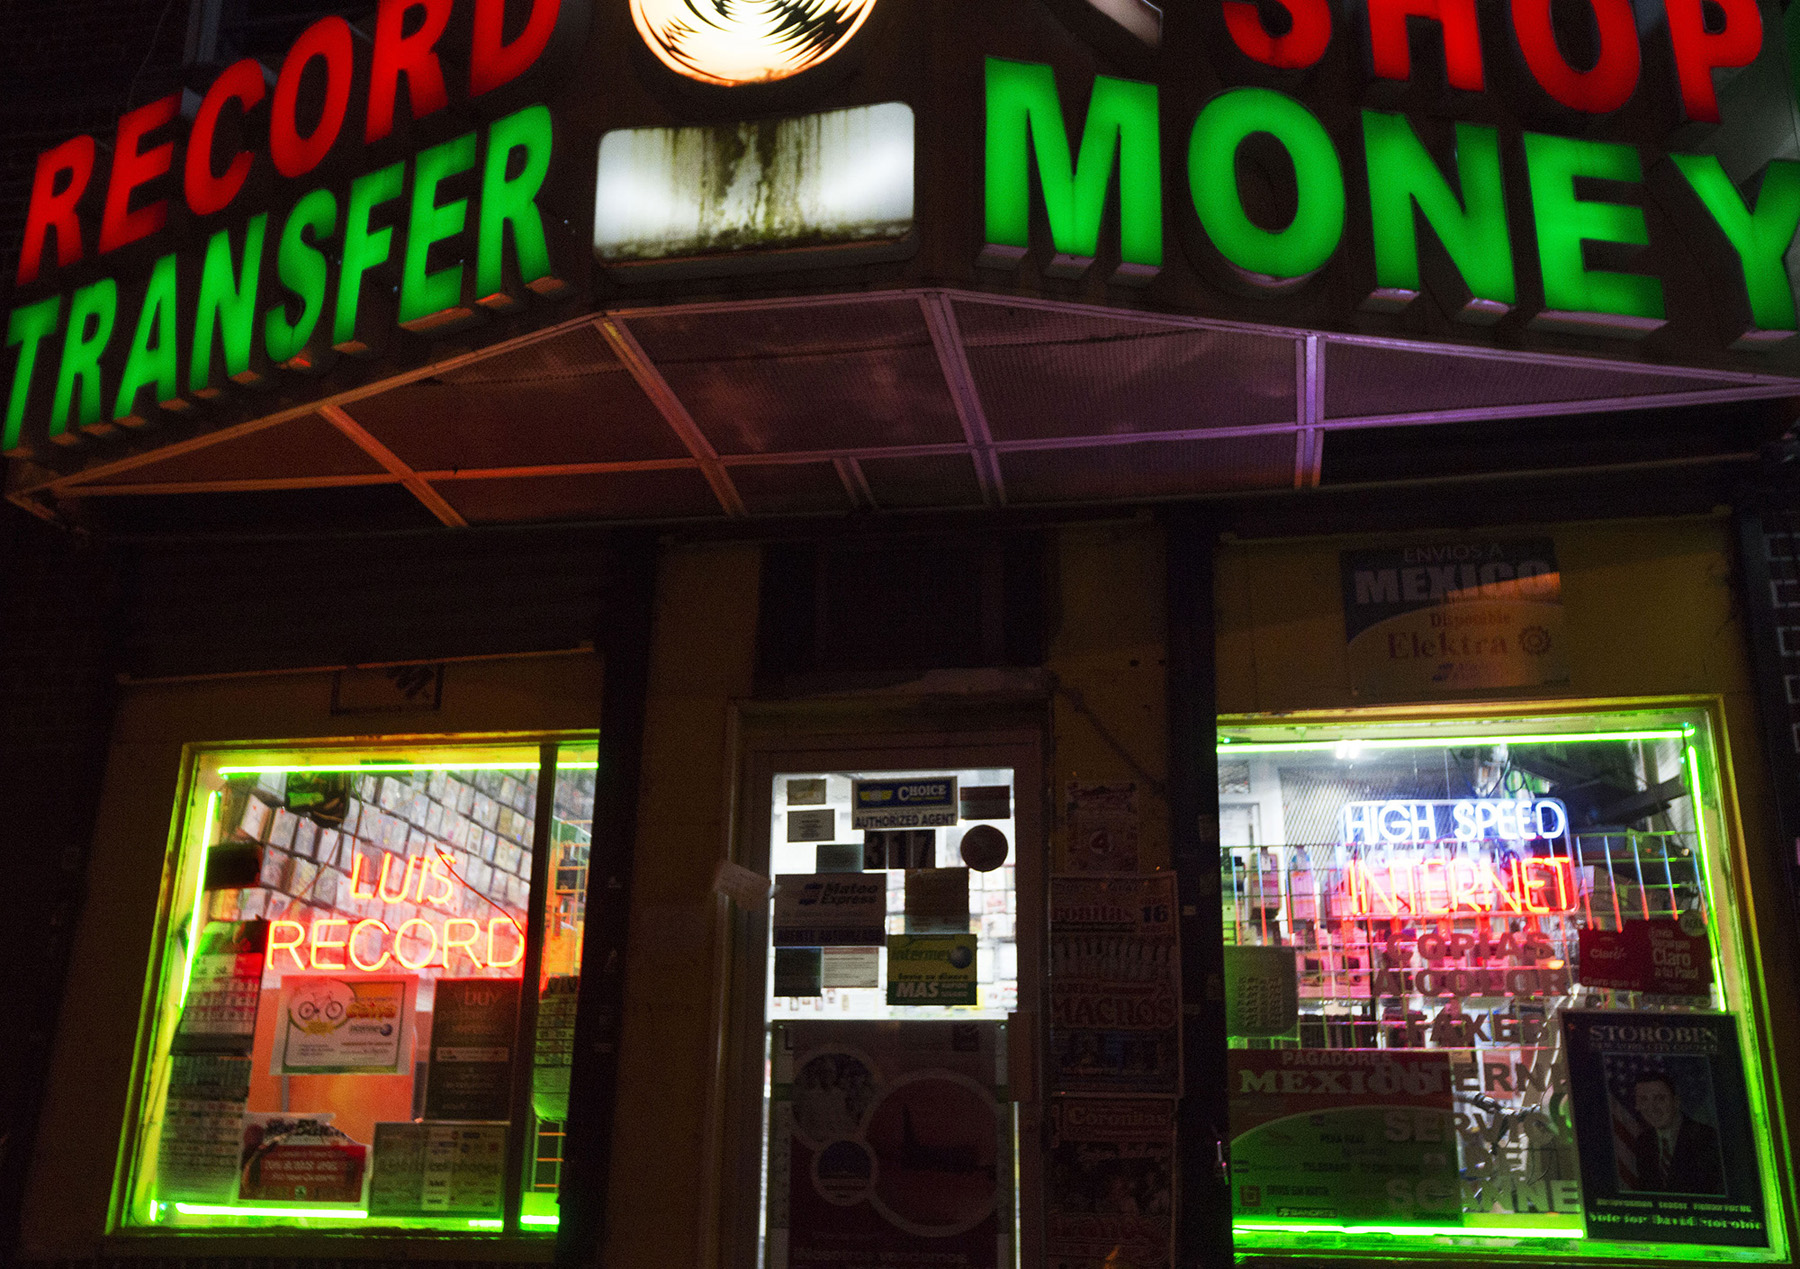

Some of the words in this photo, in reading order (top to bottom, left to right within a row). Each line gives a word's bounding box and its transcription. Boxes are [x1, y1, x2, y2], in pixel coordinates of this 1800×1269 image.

[15, 0, 562, 286] RECORD
[984, 55, 1800, 331] MONEY
[2, 102, 553, 451] TRANSFER
[1354, 560, 1552, 605] MEXICO
[1388, 631, 1508, 660] Elektra
[855, 814, 919, 829] AUTHORIZED
[922, 812, 956, 826] AGENT
[1347, 802, 1437, 845] HIGH
[1453, 799, 1566, 842] SPEED
[866, 831, 933, 869] 317
[350, 852, 457, 904] LUIS
[1348, 856, 1571, 915] INTERNET
[1142, 905, 1169, 924] 16
[265, 917, 526, 971] RECORD
[1386, 931, 1555, 962] COPIAS
[1652, 947, 1691, 967] Claro
[895, 982, 939, 998] MAS
[1415, 969, 1568, 997] COLOR
[1589, 1024, 1719, 1043] STOROBIN
[1281, 1051, 1393, 1066] PAGADORES
